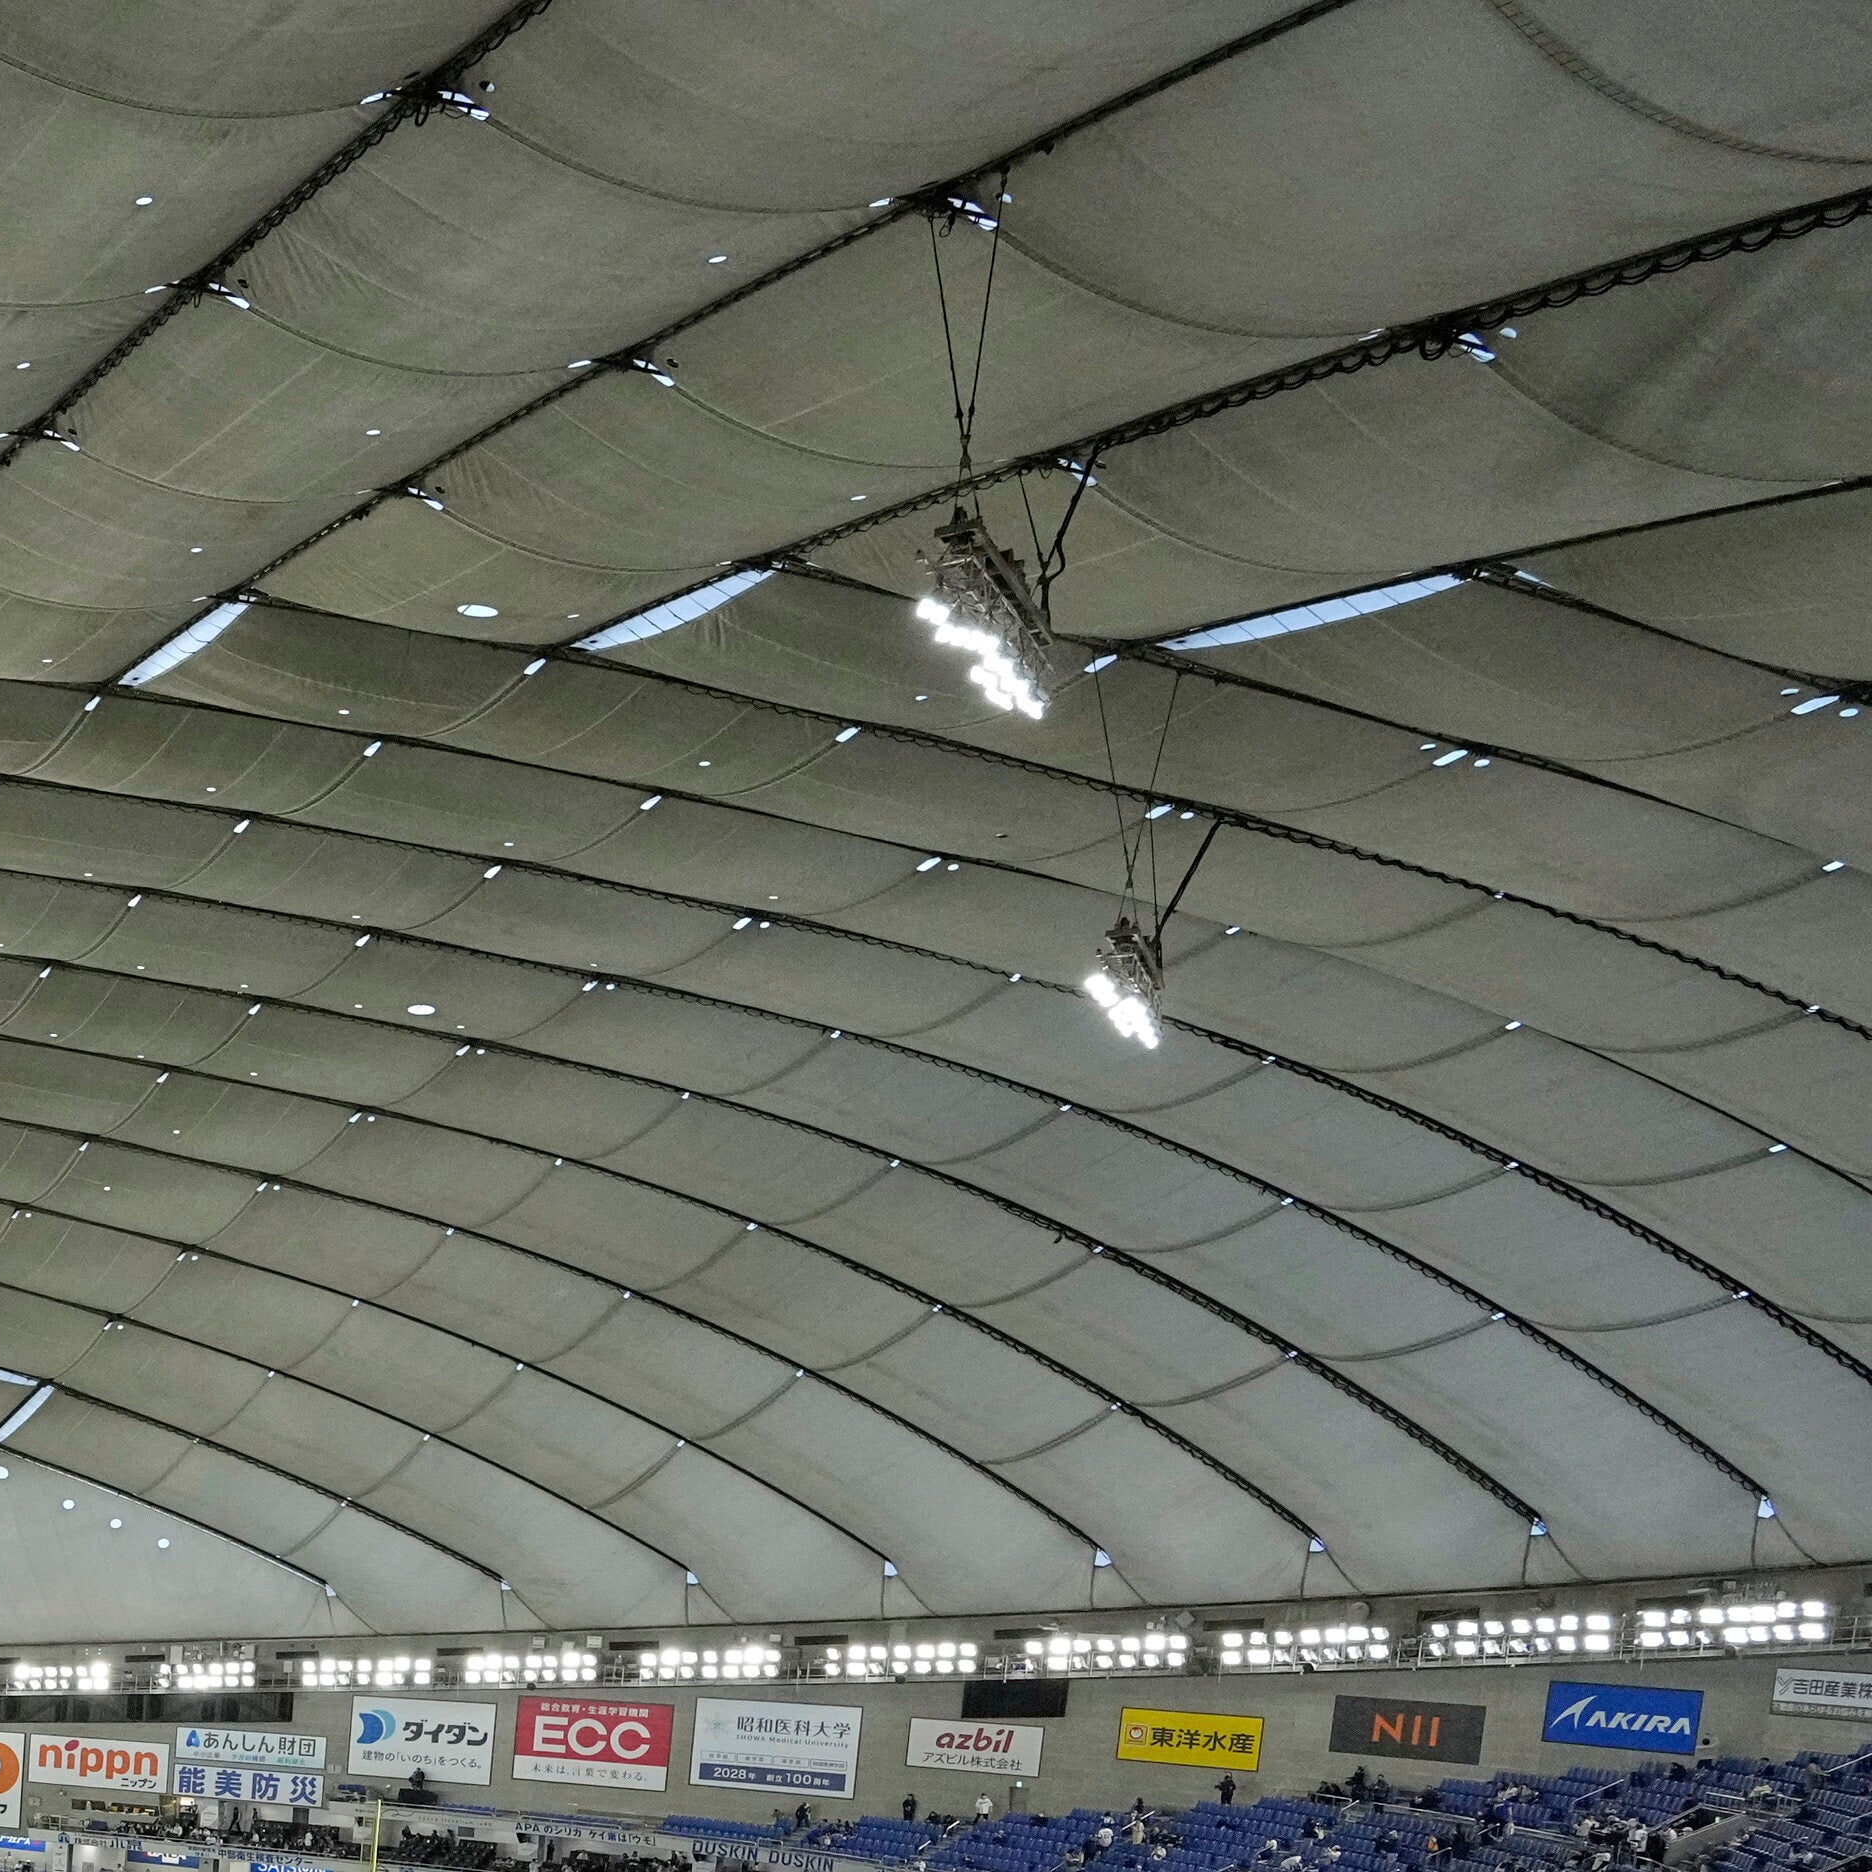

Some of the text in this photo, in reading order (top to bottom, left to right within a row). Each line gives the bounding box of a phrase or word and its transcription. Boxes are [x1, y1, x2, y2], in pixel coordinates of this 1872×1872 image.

[403, 1719, 489, 1746] ダイダン
[737, 1715, 851, 1739] 昭和医科大学
[1586, 1710, 1691, 1735] AKIRA
[203, 1731, 317, 1757] あんしん財団
[533, 1715, 651, 1760] ECC
[736, 1734, 850, 1749] SHOWA Medical University
[936, 1728, 1015, 1753] azbil
[1150, 1727, 1255, 1754] 東洋水産
[39, 1739, 160, 1778] nippn
[924, 1752, 1022, 1771] アズビル株式会社
[120, 1777, 157, 1790] ニップン
[177, 1766, 319, 1801] 能美防災
[713, 1767, 756, 1781] 2028年
[692, 1840, 759, 1861] DUSKIN
[769, 1850, 834, 1872] DUSKIN
